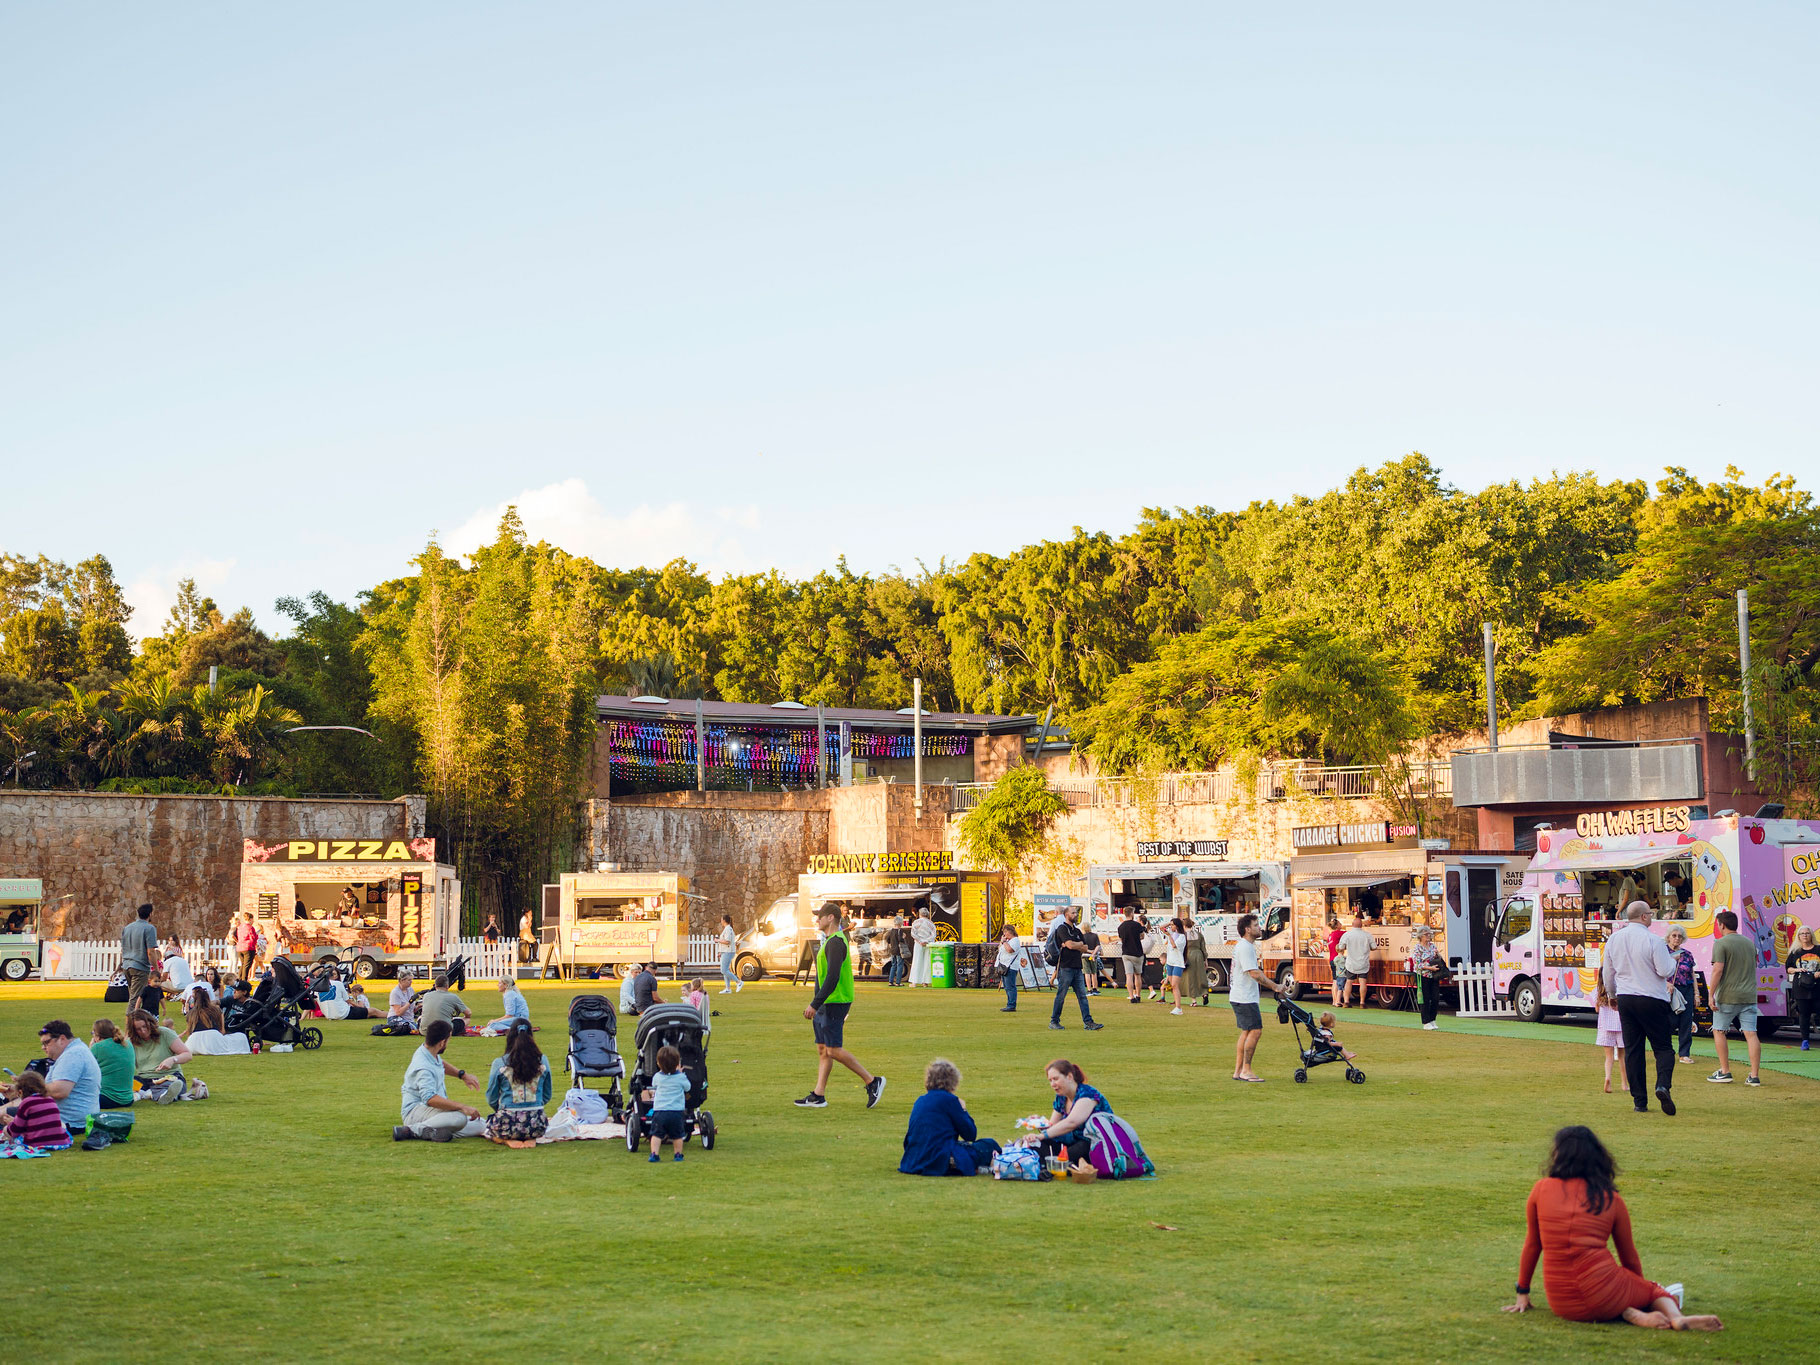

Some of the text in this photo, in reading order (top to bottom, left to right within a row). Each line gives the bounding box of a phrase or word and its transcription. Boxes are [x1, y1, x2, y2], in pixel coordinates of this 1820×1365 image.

[1576, 805, 1691, 838] OH WAFFLES
[1293, 823, 1386, 847] KARAAGE CHICKEN
[1389, 825, 1416, 837] FUSION
[267, 842, 288, 853] Italian
[288, 841, 411, 860] PIZZA
[1137, 841, 1228, 856] BEST OF THE WURST
[807, 851, 954, 874] JOHNNY BRISKET
[401, 881, 420, 946] PIZZA
[1376, 938, 1390, 947] USE
[1498, 962, 1522, 970] WAFFLES
